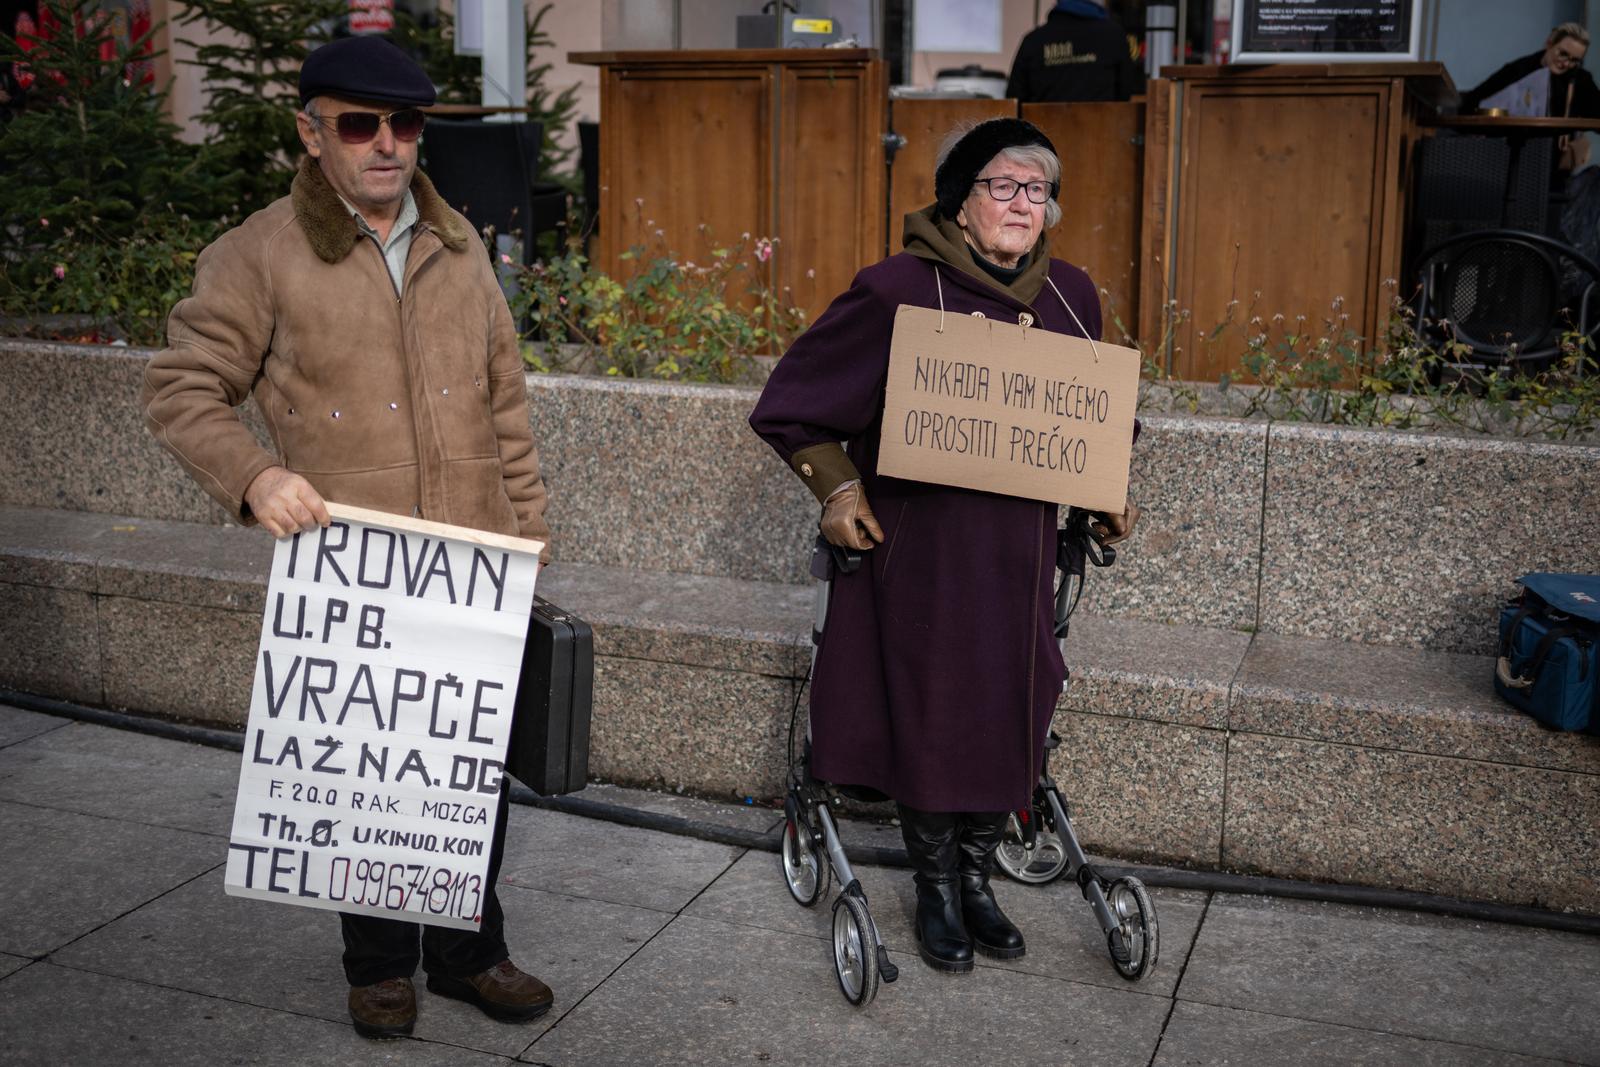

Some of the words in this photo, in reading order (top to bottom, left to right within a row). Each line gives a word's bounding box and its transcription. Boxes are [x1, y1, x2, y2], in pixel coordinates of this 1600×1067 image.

[914, 356, 990, 402] NIKADA
[1001, 371, 1036, 409] VAM
[1043, 376, 1109, 423] NEĆEMO
[905, 409, 998, 459] OPROSTITI
[1009, 425, 1087, 474] PREČKO
[263, 650, 503, 744] VRAPČE
[351, 792, 400, 814] RAK
[421, 800, 487, 825] MOZGA
[229, 842, 320, 898] TEL
